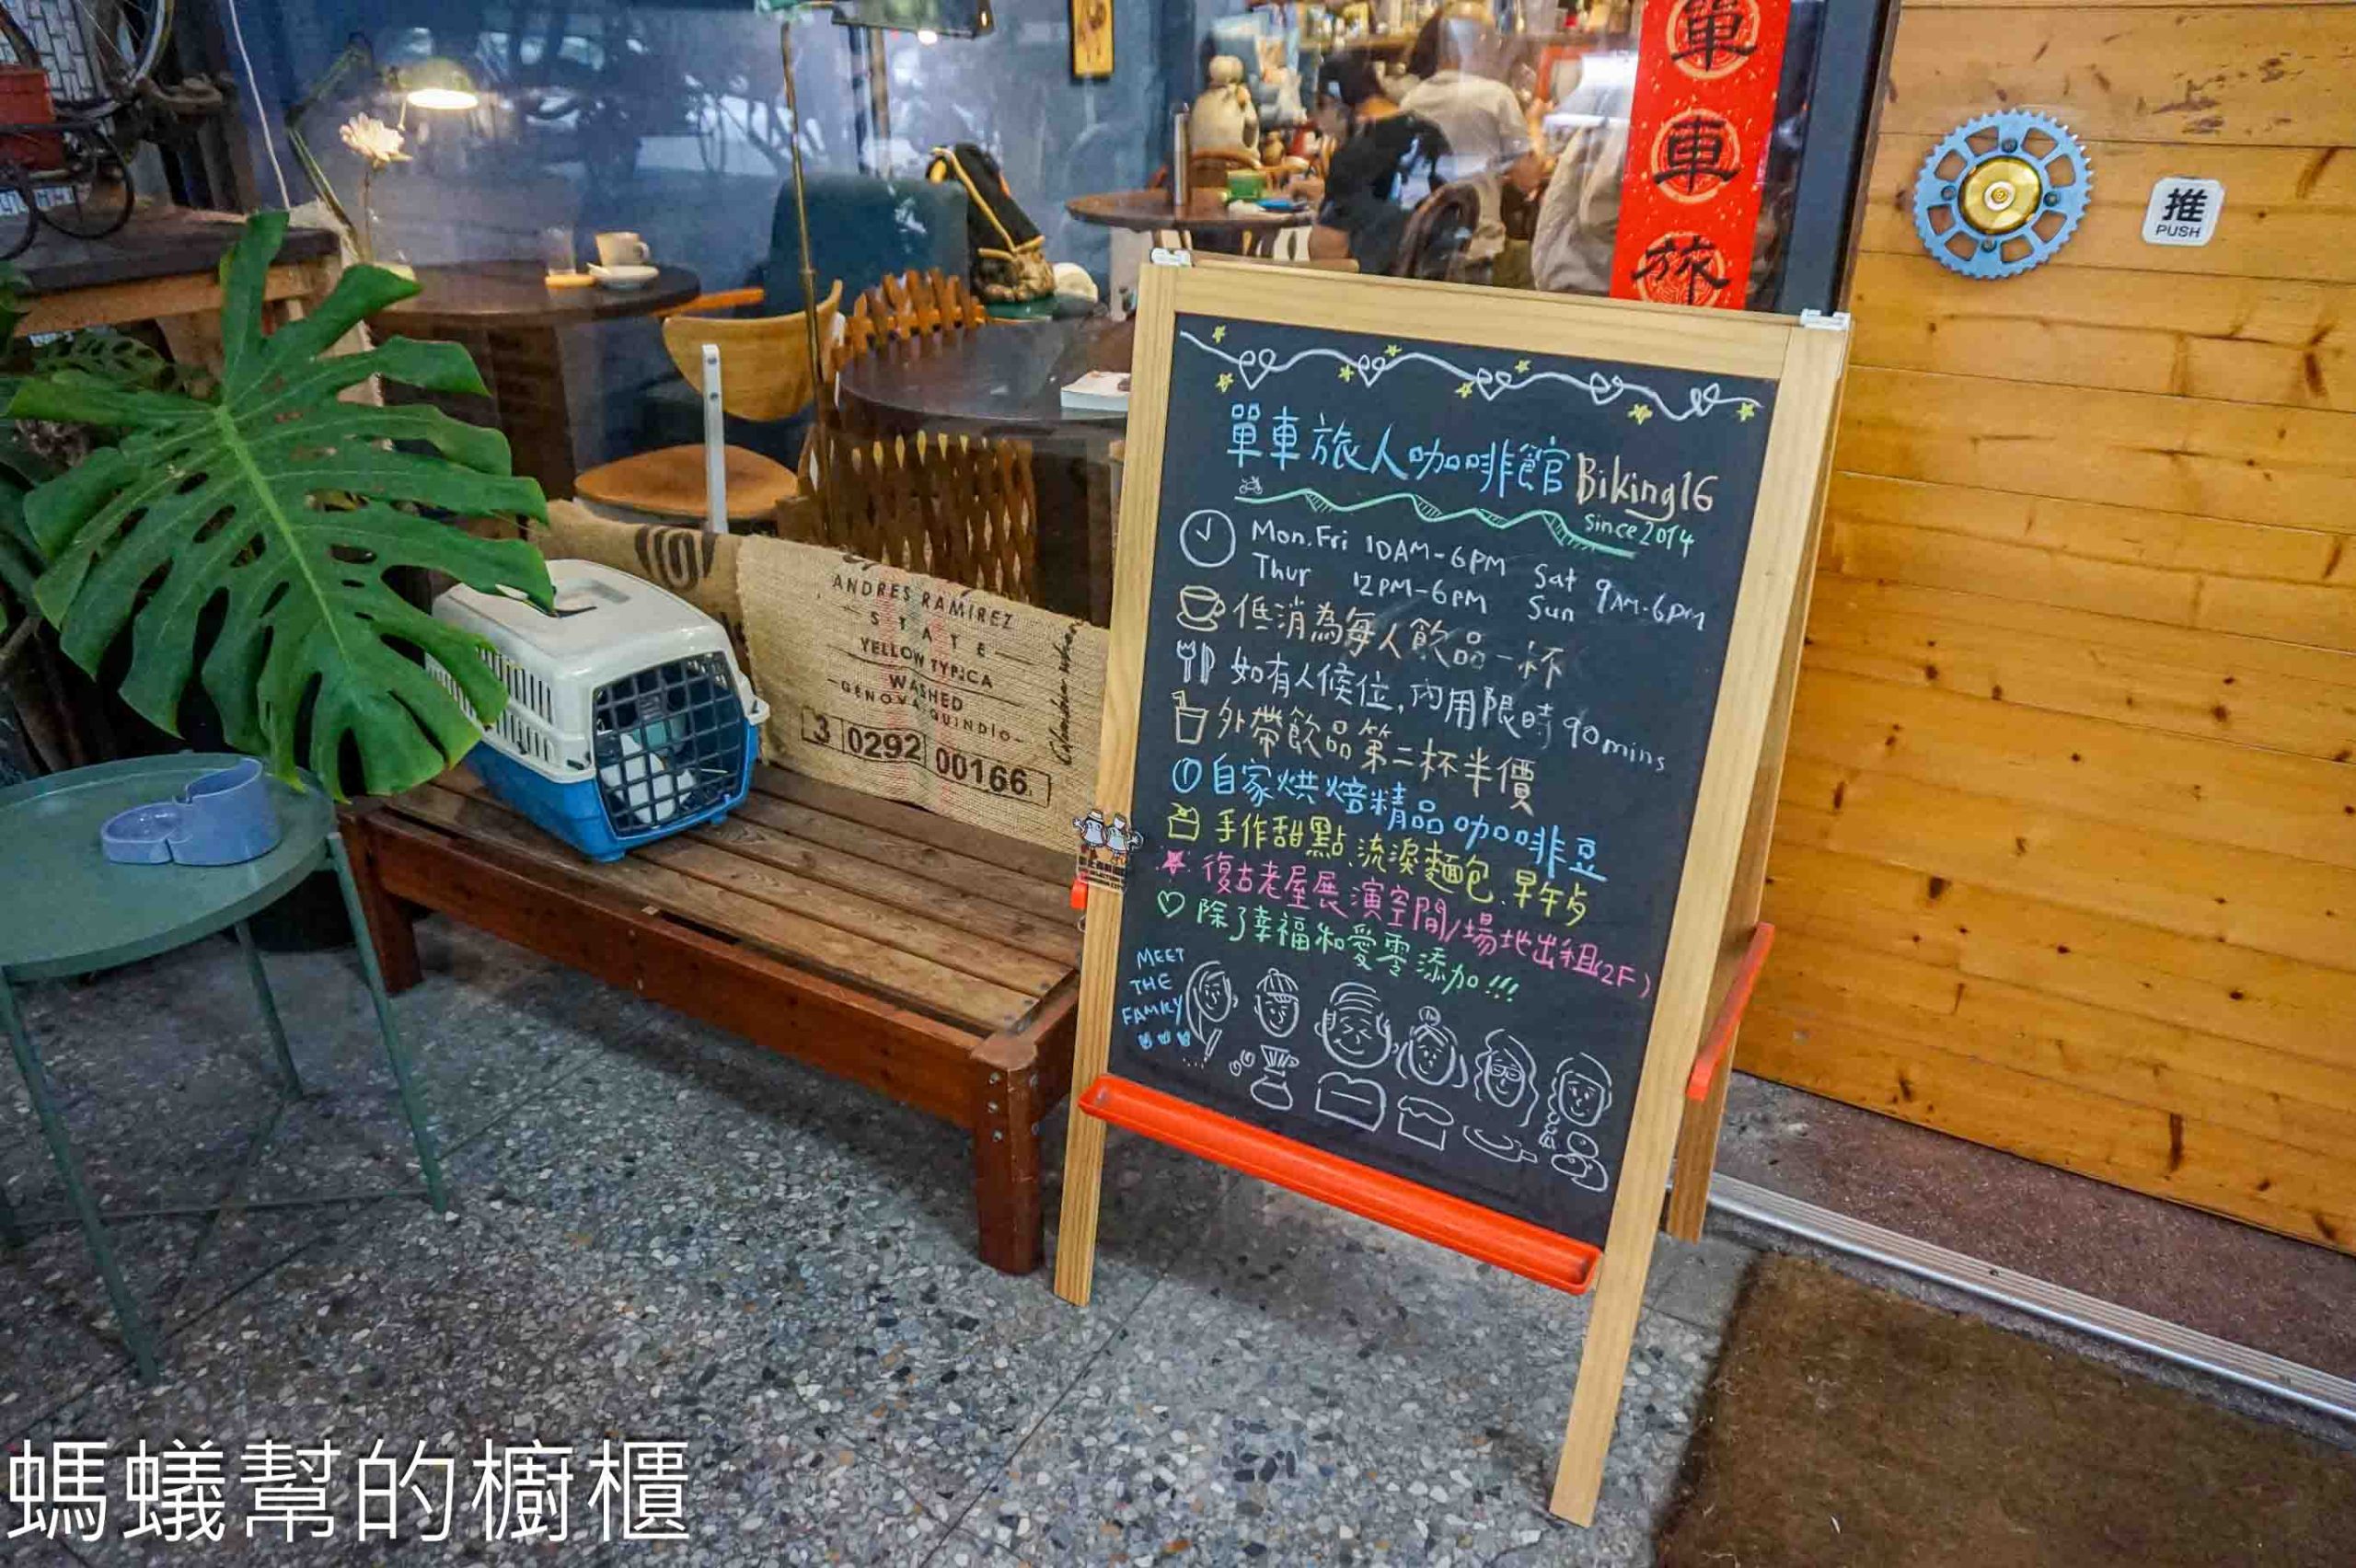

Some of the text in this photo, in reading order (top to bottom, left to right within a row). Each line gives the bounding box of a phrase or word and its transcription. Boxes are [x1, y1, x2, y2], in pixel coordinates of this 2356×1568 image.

[2162, 188, 2208, 223] 推
[2154, 224, 2201, 238] PUSH
[1226, 402, 1719, 522] 單車旅人咖啡館 Biking16
[1252, 551, 1312, 587] Thur
[1533, 563, 1577, 593] Sat
[832, 573, 1013, 629] ANDRES RAMIREZ
[1527, 594, 1576, 622] Sun
[860, 636, 925, 668] YELLOW
[888, 673, 964, 712] WASHED
[813, 713, 1029, 796] 3 0292 00166
[1136, 947, 1185, 971] MEET
[1128, 972, 1173, 997] THE
